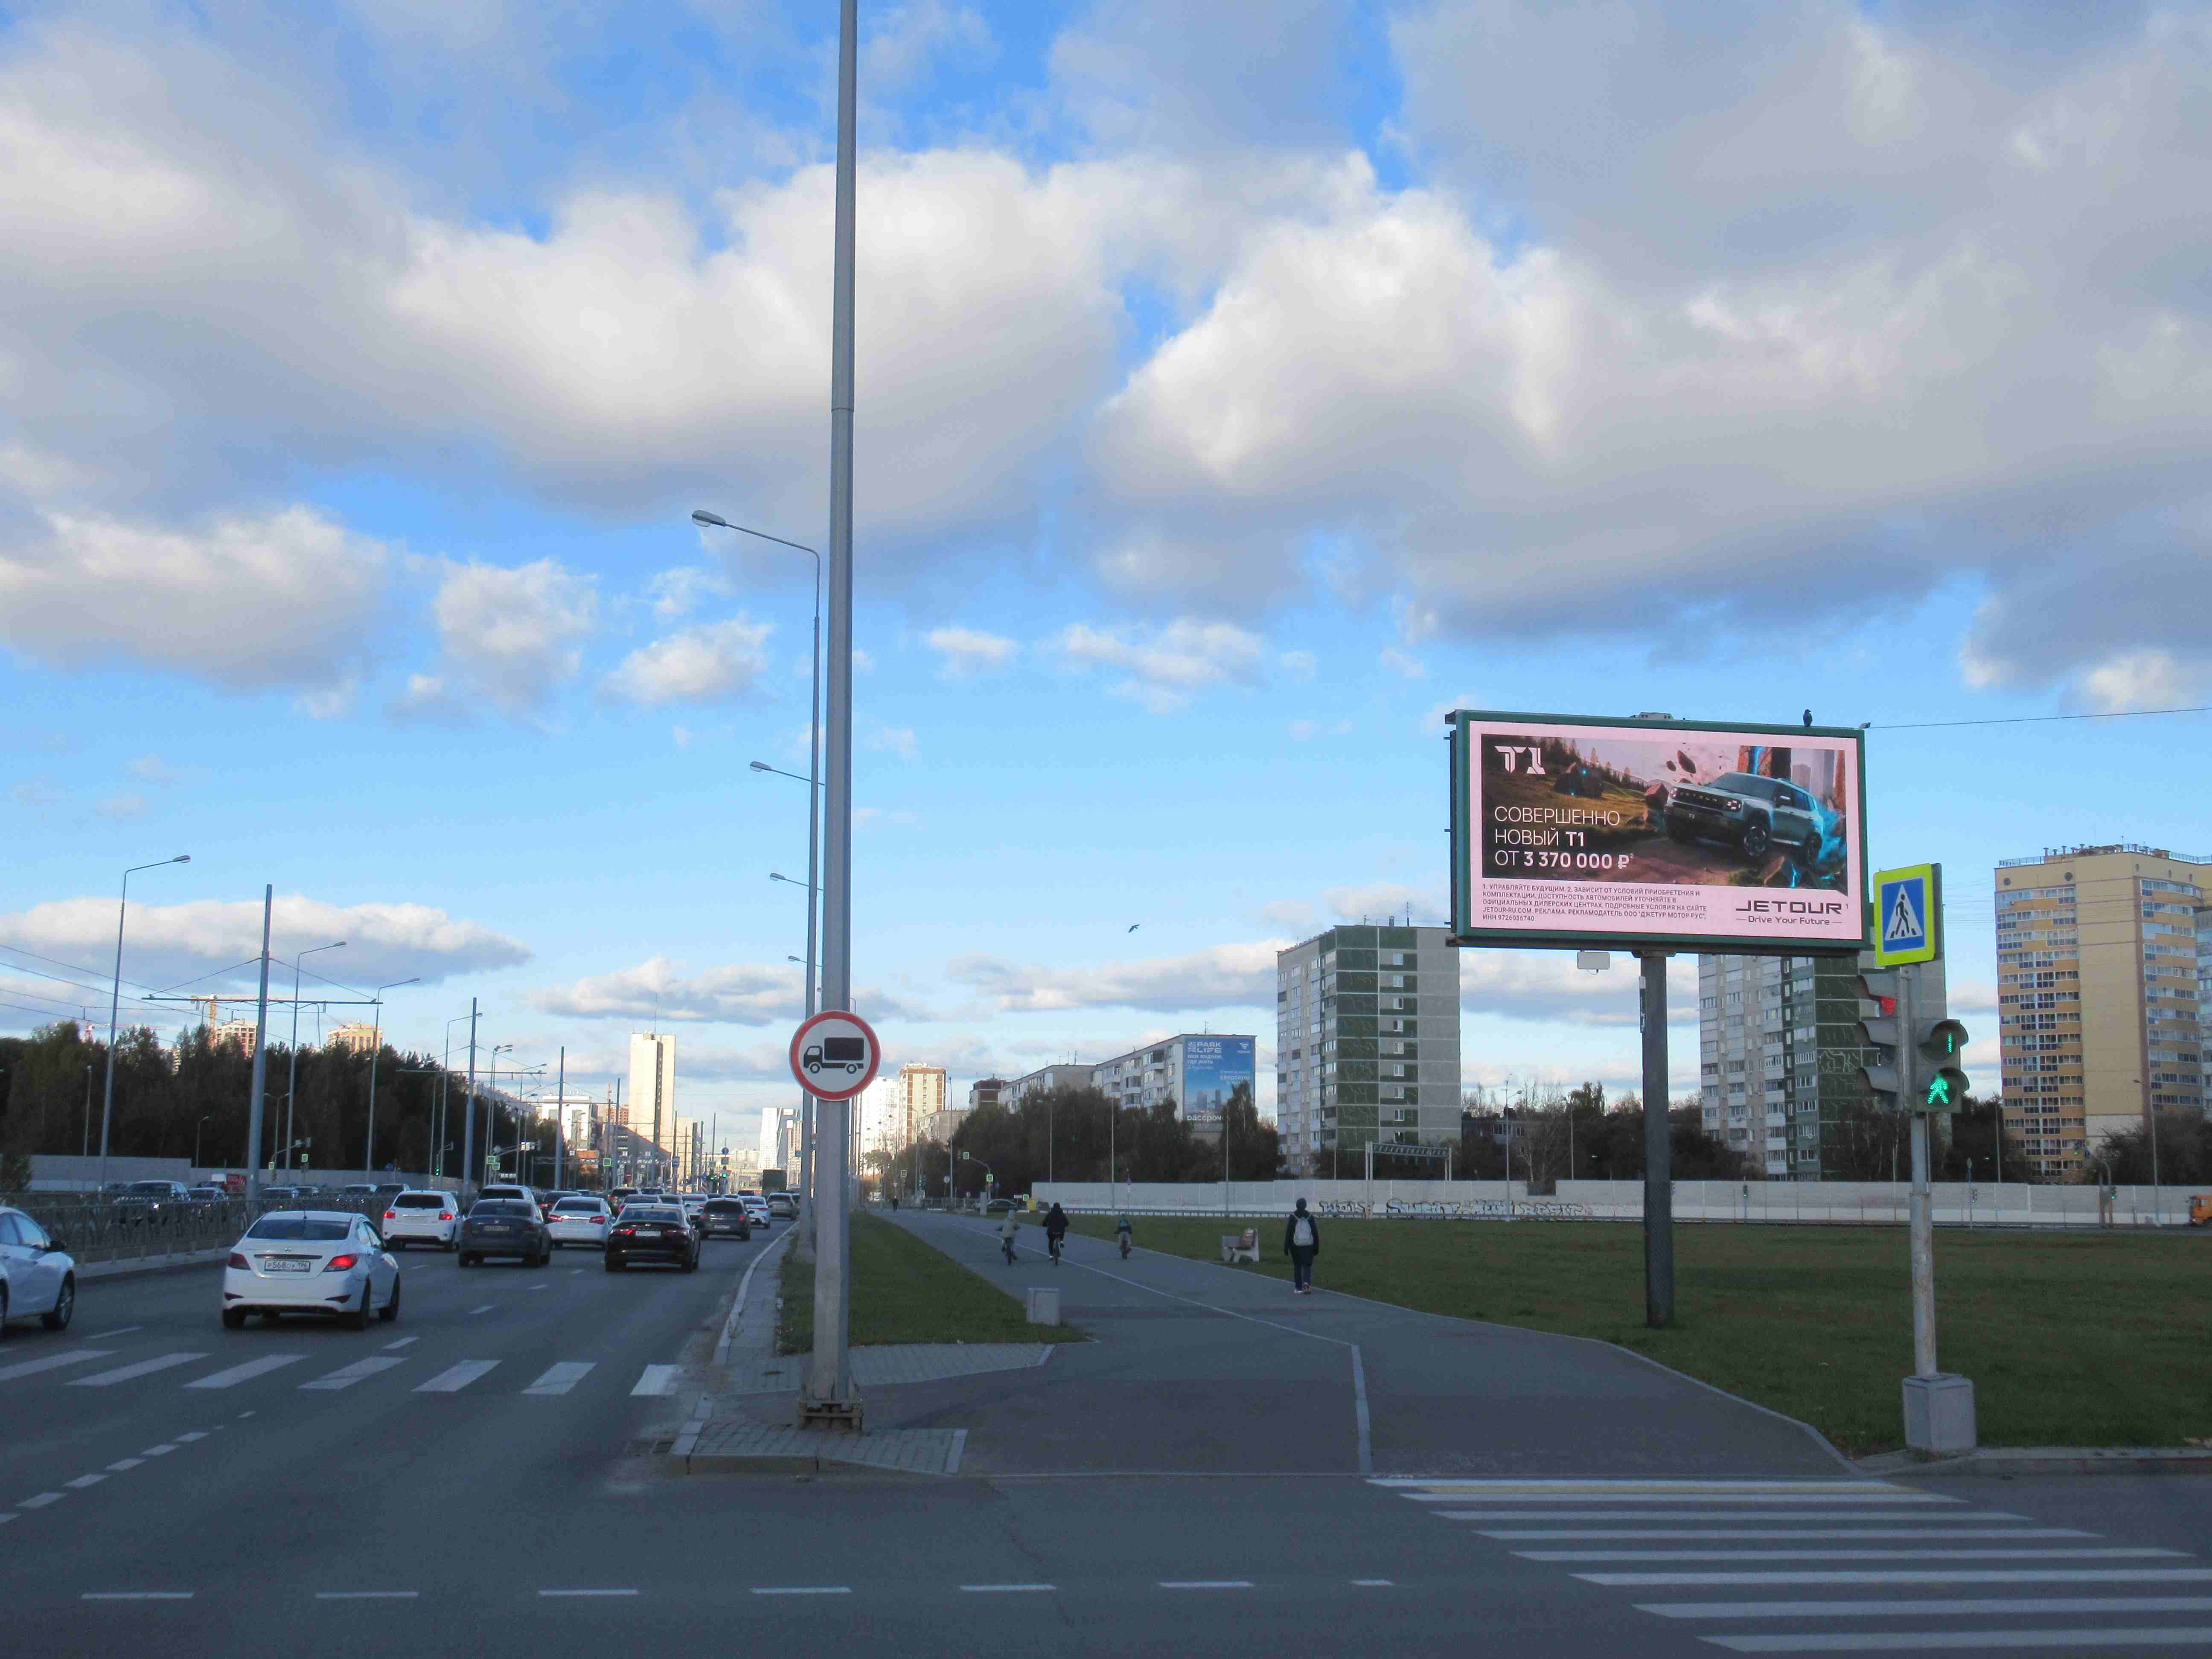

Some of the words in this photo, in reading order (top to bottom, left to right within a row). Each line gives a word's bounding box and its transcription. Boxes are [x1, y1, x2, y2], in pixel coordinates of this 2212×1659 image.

[1494, 745, 1546, 775] T1
[1494, 806, 1620, 826] СОВЕРШЕННО
[1495, 827, 1559, 846] НОВЫЙ
[1495, 850, 1519, 866] ОТ
[1523, 851, 1534, 867] 3
[1538, 852, 1571, 868] 370
[1576, 853, 1612, 869] 000
[1735, 900, 1842, 915] JETOUR
